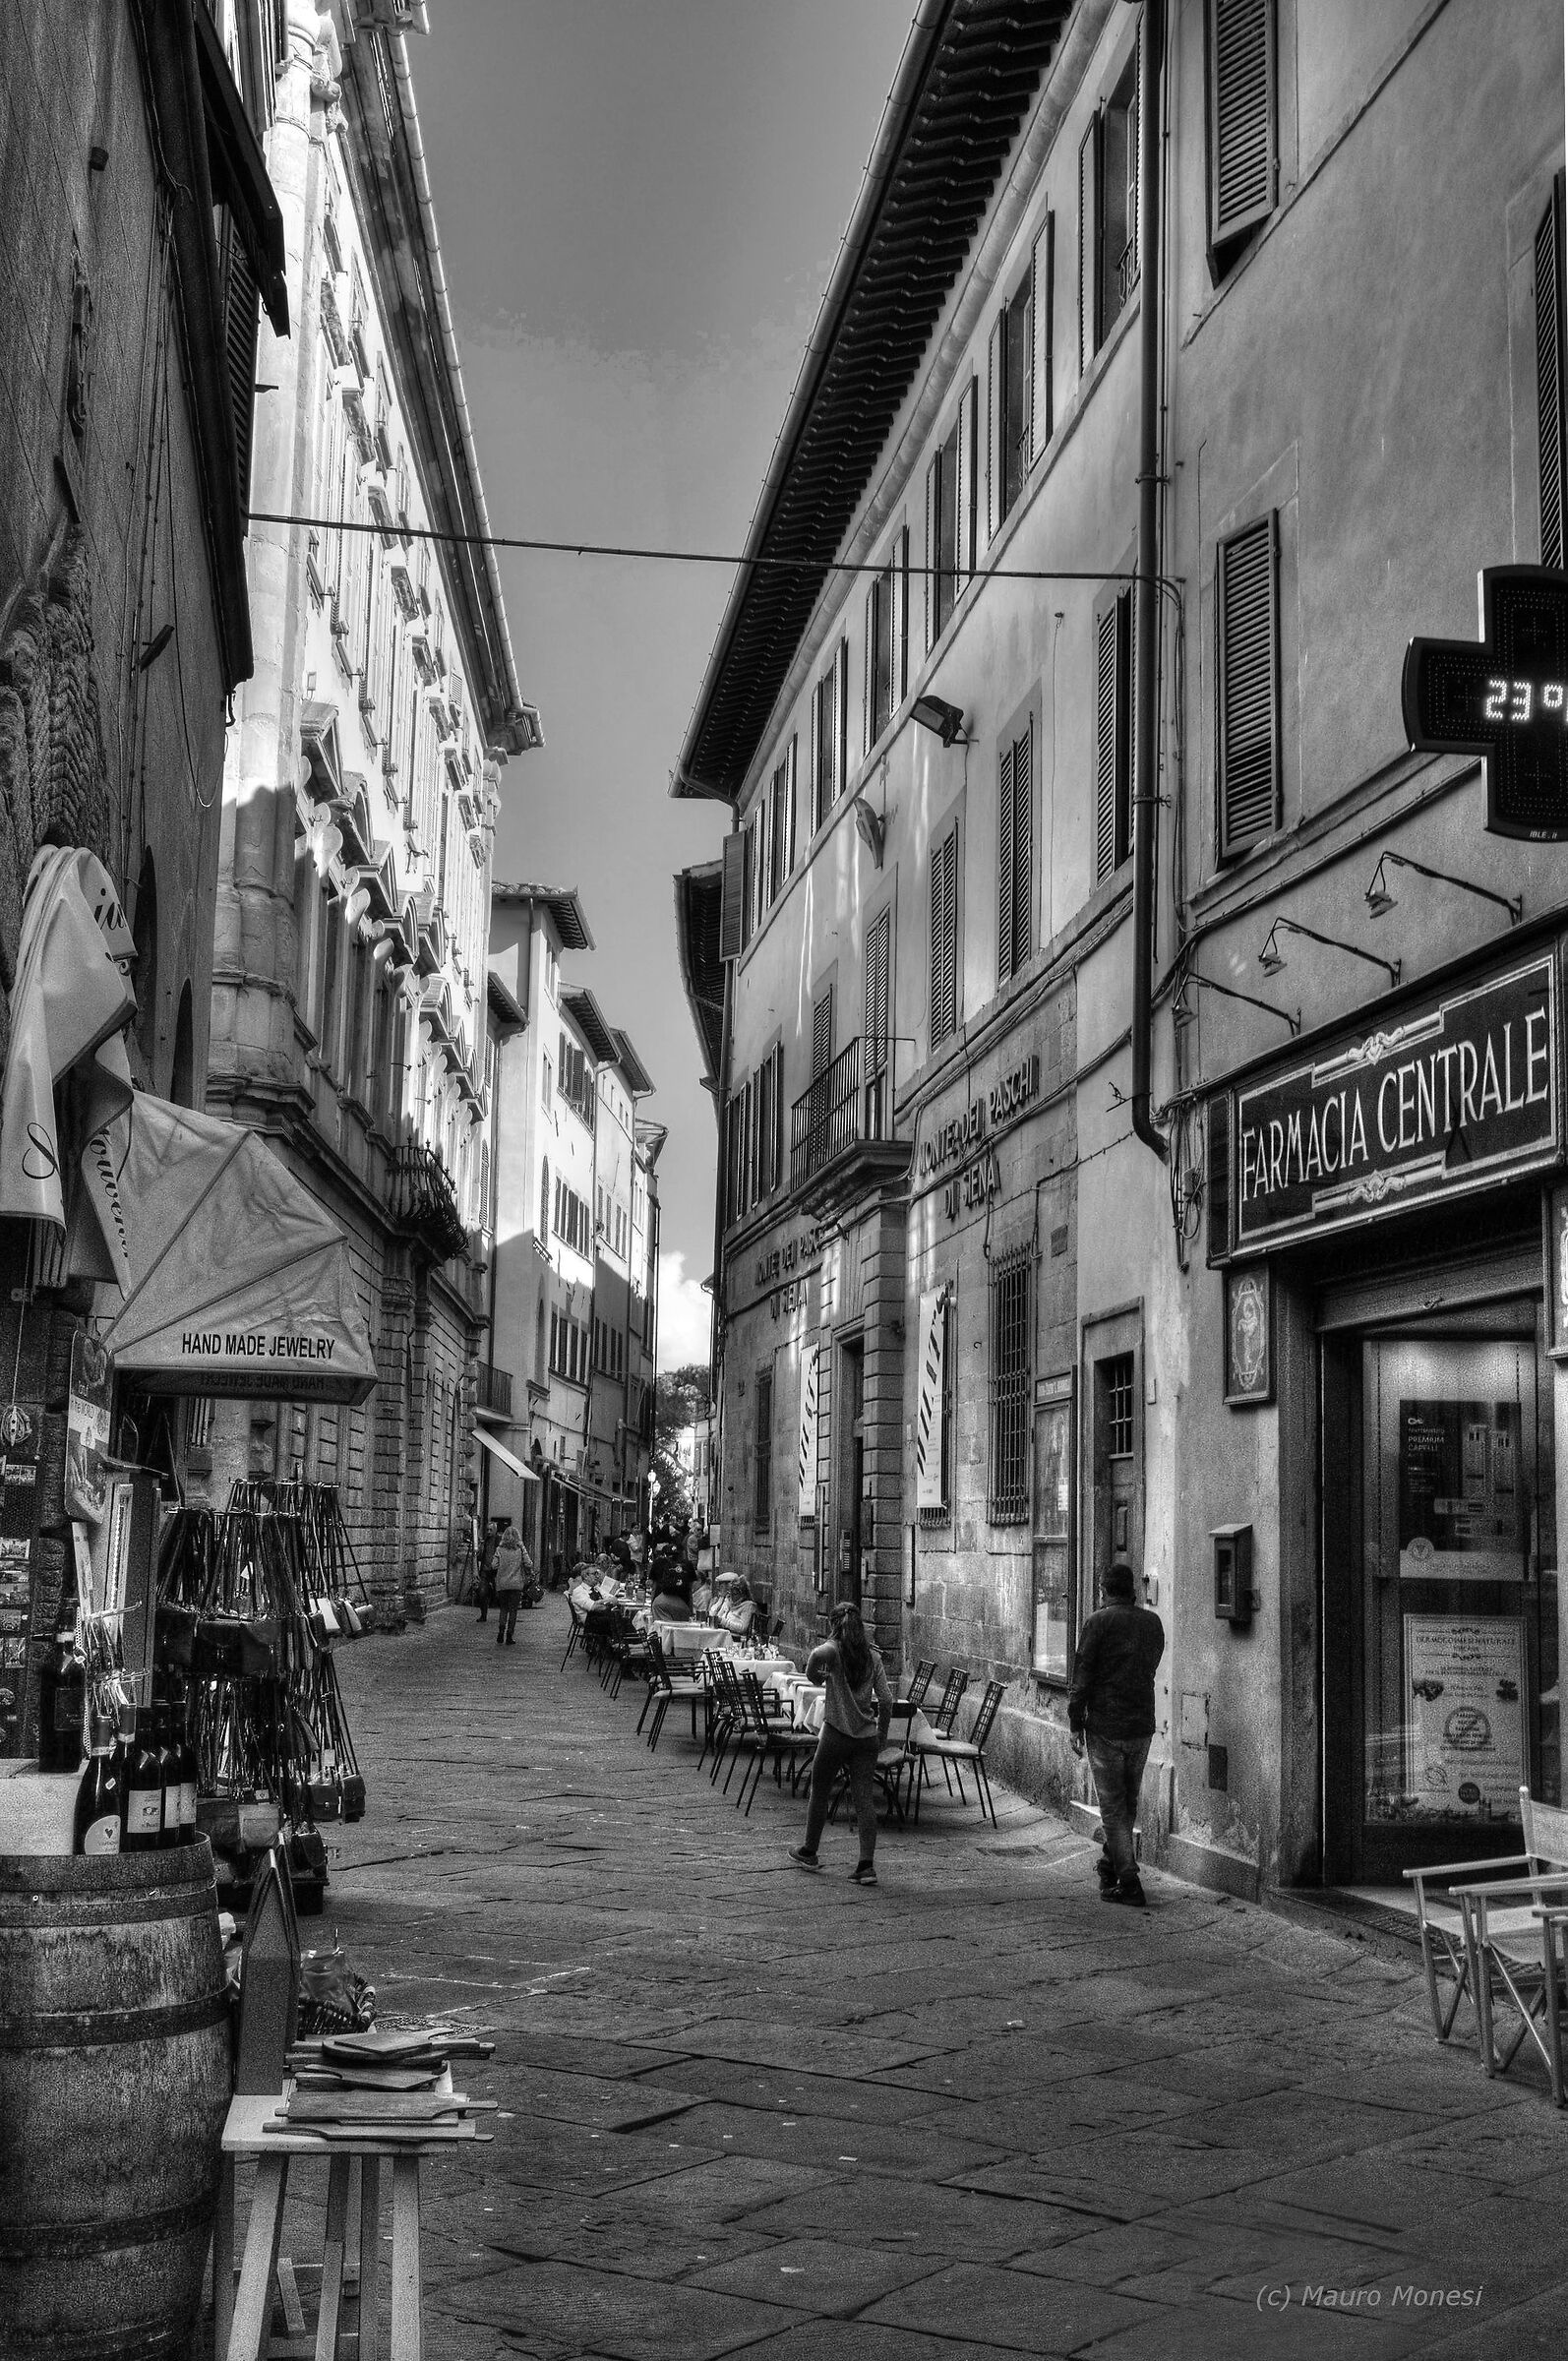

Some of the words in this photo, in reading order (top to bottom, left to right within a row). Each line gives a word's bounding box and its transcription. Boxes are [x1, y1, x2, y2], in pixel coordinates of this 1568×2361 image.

[1485, 679, 1568, 723] 23°
[918, 1120, 958, 1174] MONTE
[961, 1099, 984, 1144] DEI
[989, 1058, 1038, 1120] PASCHI
[1242, 1087, 1368, 1202] FARMACIA
[1377, 1007, 1548, 1153] CENTRALE
[944, 1180, 960, 1220] DI
[962, 1151, 997, 1207] SIENA
[181, 1333, 221, 1355] HAND
[225, 1334, 266, 1356] MADE
[270, 1336, 335, 1360] JEWELRY
